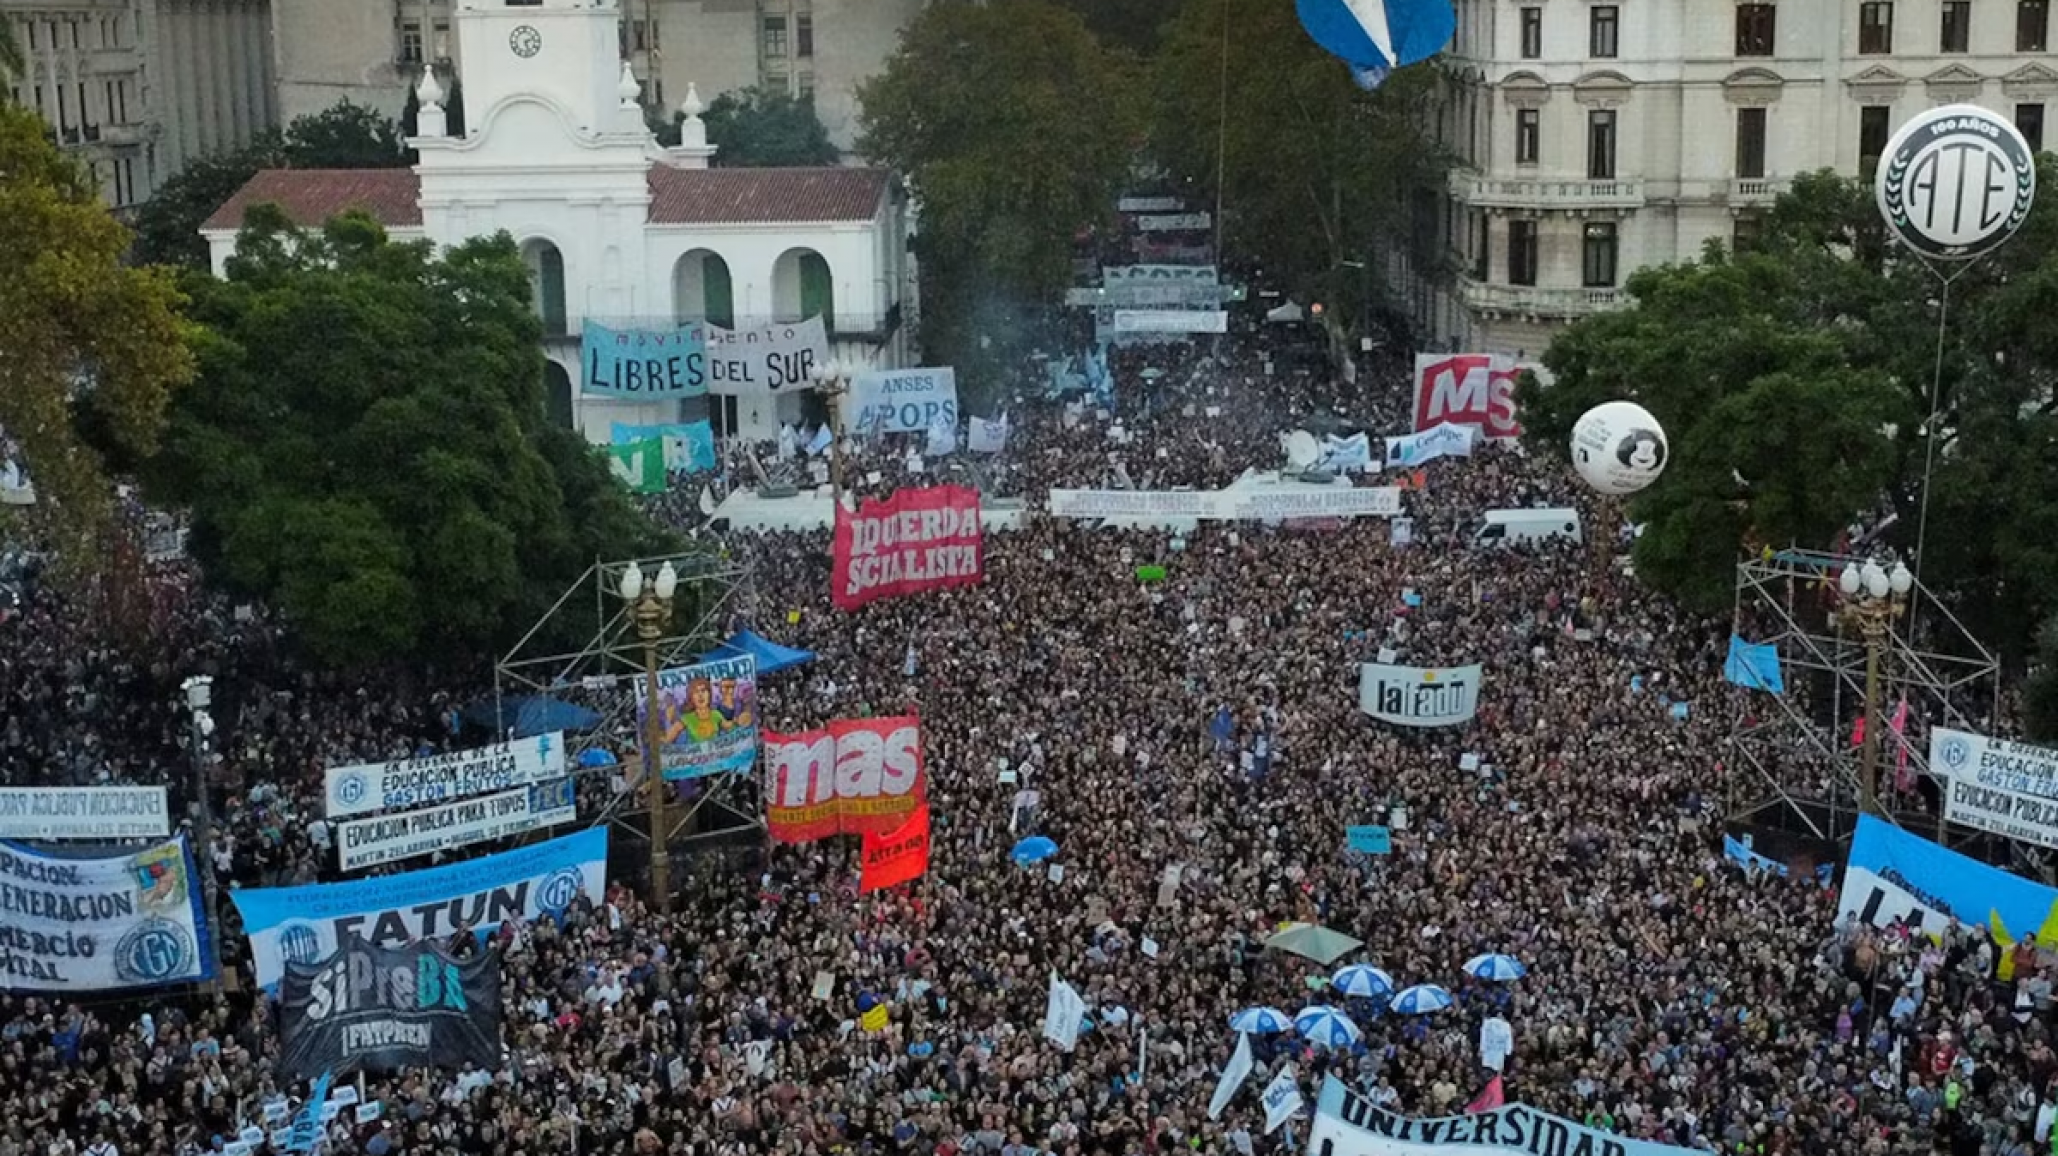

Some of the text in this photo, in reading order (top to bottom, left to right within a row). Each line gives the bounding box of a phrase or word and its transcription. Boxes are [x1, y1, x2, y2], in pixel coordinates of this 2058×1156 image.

[1931, 117, 1999, 137] 100 AÑOS
[1909, 142, 2006, 234] ATE
[712, 359, 755, 382] DEL
[881, 376, 934, 394] ANSES
[776, 726, 919, 807] mas
[333, 880, 529, 948] FATUN
